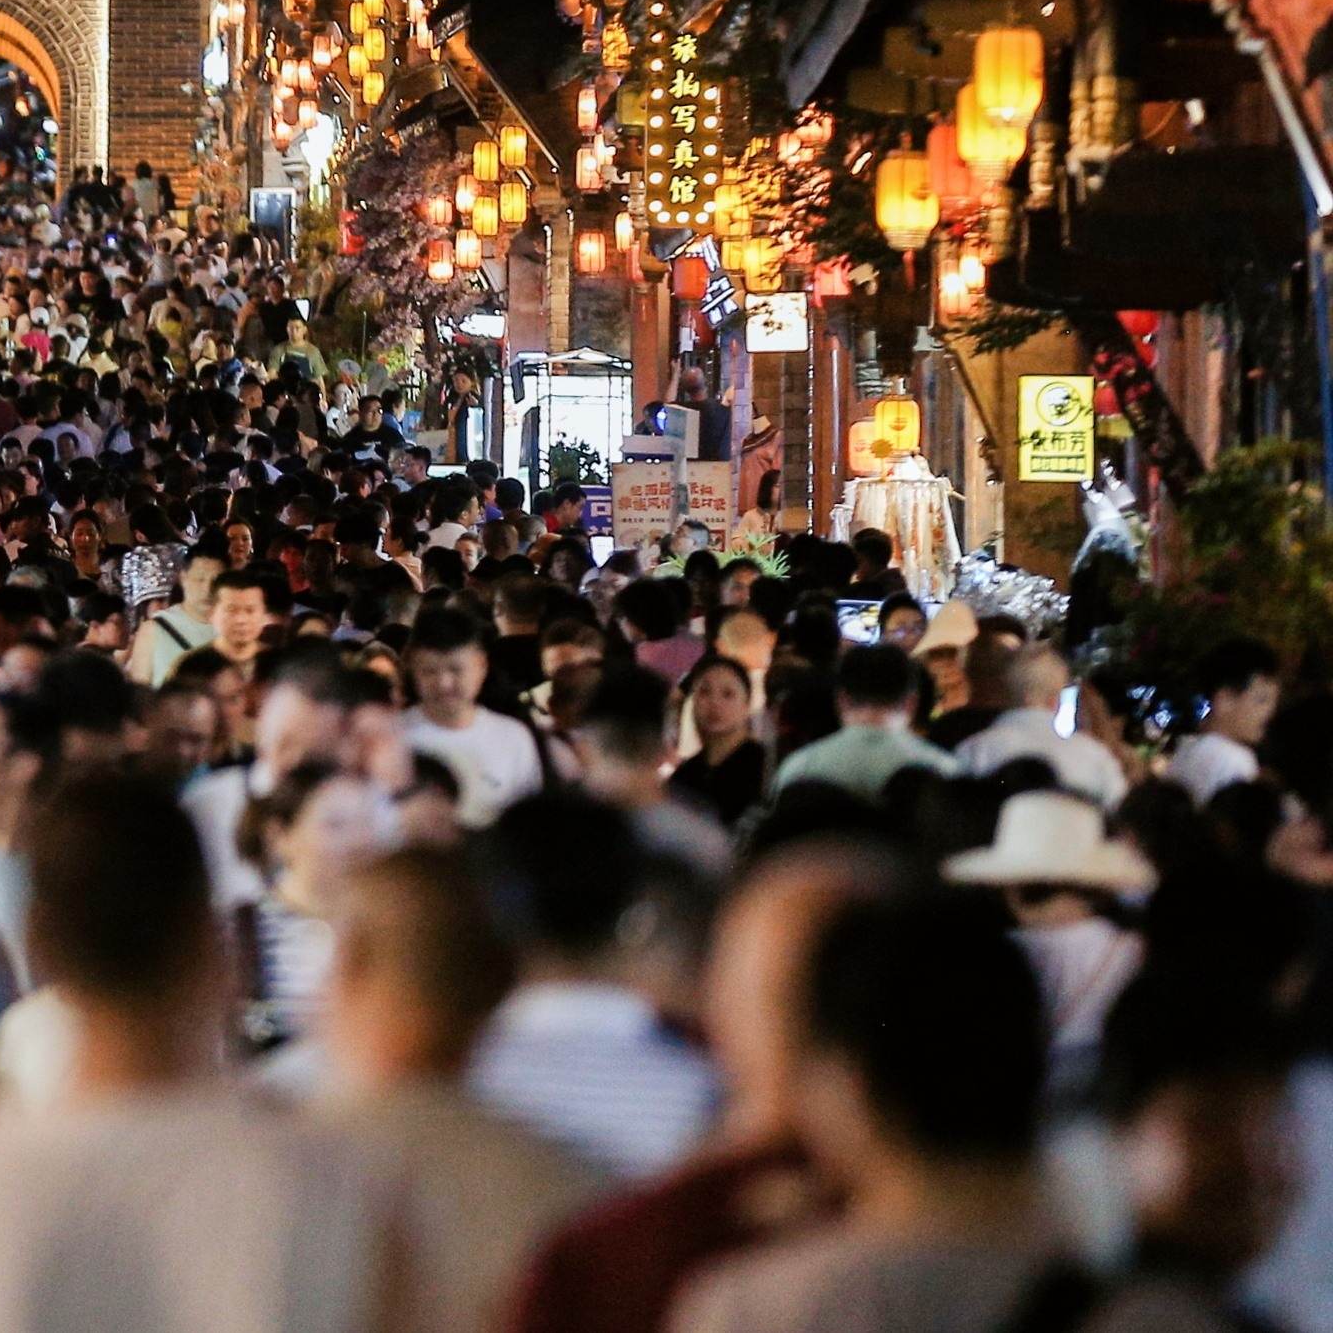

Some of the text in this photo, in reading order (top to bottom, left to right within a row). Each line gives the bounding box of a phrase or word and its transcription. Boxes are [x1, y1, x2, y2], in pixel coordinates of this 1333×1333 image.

[668, 33, 701, 205] 旅拍写真馆
